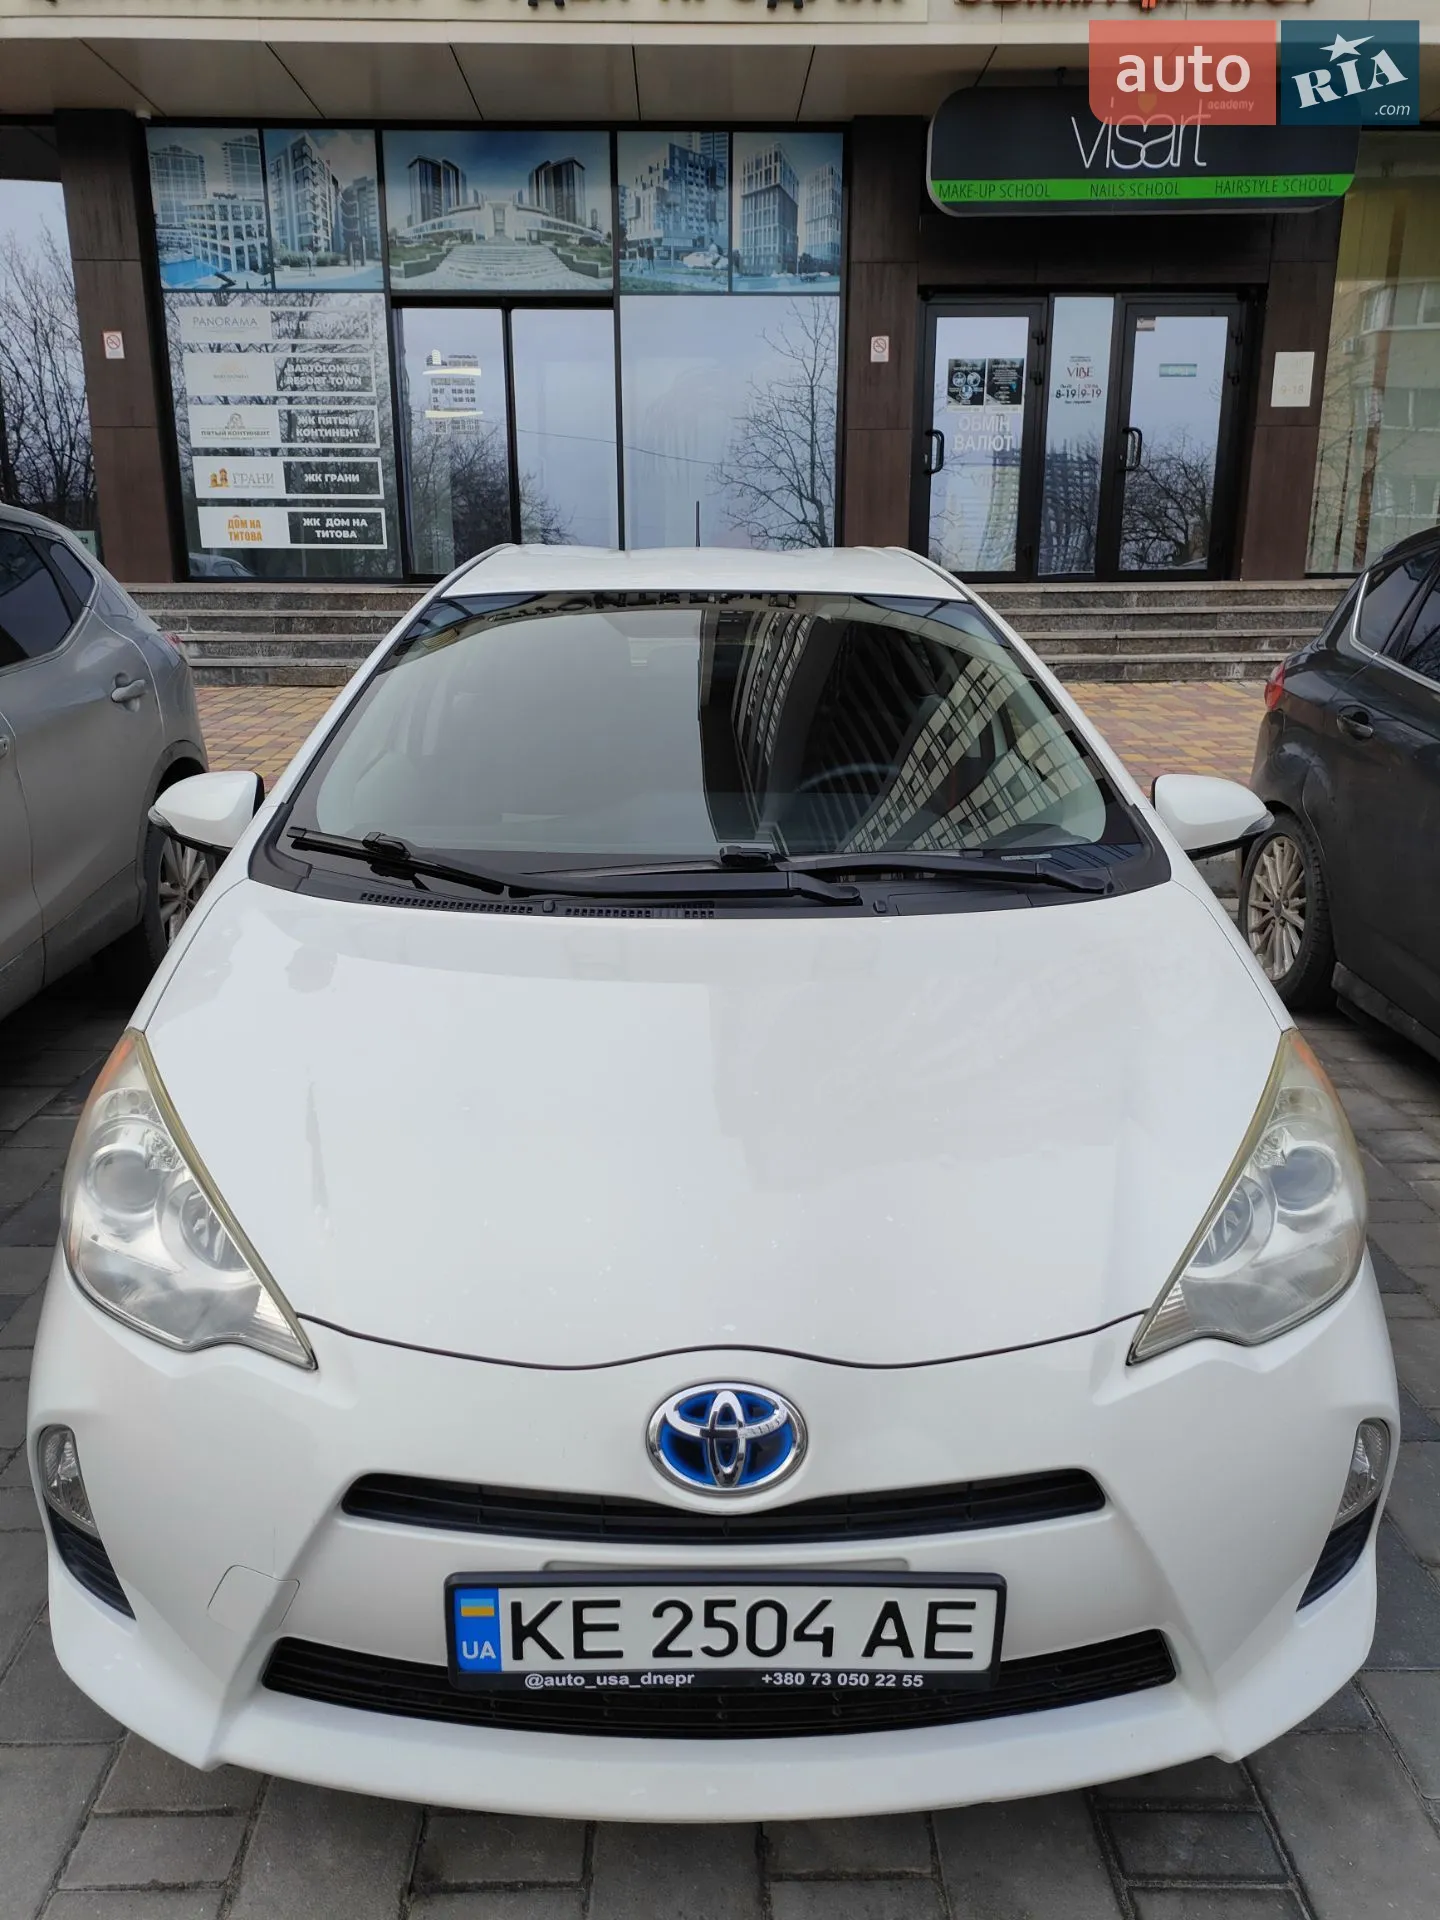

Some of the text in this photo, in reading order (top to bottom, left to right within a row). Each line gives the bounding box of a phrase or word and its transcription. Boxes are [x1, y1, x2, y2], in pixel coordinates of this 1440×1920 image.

[1207, 99, 1255, 112] academy
[938, 183, 1050, 198] MAKE-UP SCHOOL
[1090, 181, 1180, 198] NAILS SCHOOL
[1215, 177, 1334, 194] HAIRSTYLE SCHOOL
[192, 316, 259, 327] PANORAMA
[286, 363, 360, 373] BARTOLOMEO
[286, 376, 362, 385] RESORT TOWN
[1055, 389, 1102, 399] 8-19 9-19
[298, 415, 357, 425] ЖК ПЯТЫЙ
[958, 415, 1010, 432] ОБМІН
[296, 429, 361, 438] КОНТИНЕНТ
[953, 434, 1013, 452] ВАЛЮТ
[231, 473, 275, 485] ГРАНИ
[304, 473, 360, 482] ЖК ГРАНИ
[227, 518, 262, 530] ДОМ НА
[302, 518, 368, 528] ЖК ДОМ НА
[228, 531, 263, 542] ТИТОВА
[315, 530, 358, 539] ТИТОВА
[511, 1599, 977, 1661] KE 2504 AE
[462, 1640, 497, 1660] UA
[524, 1672, 696, 1690] @auto_usa_dnepr
[761, 1673, 924, 1688] +380 73 050 22 55
